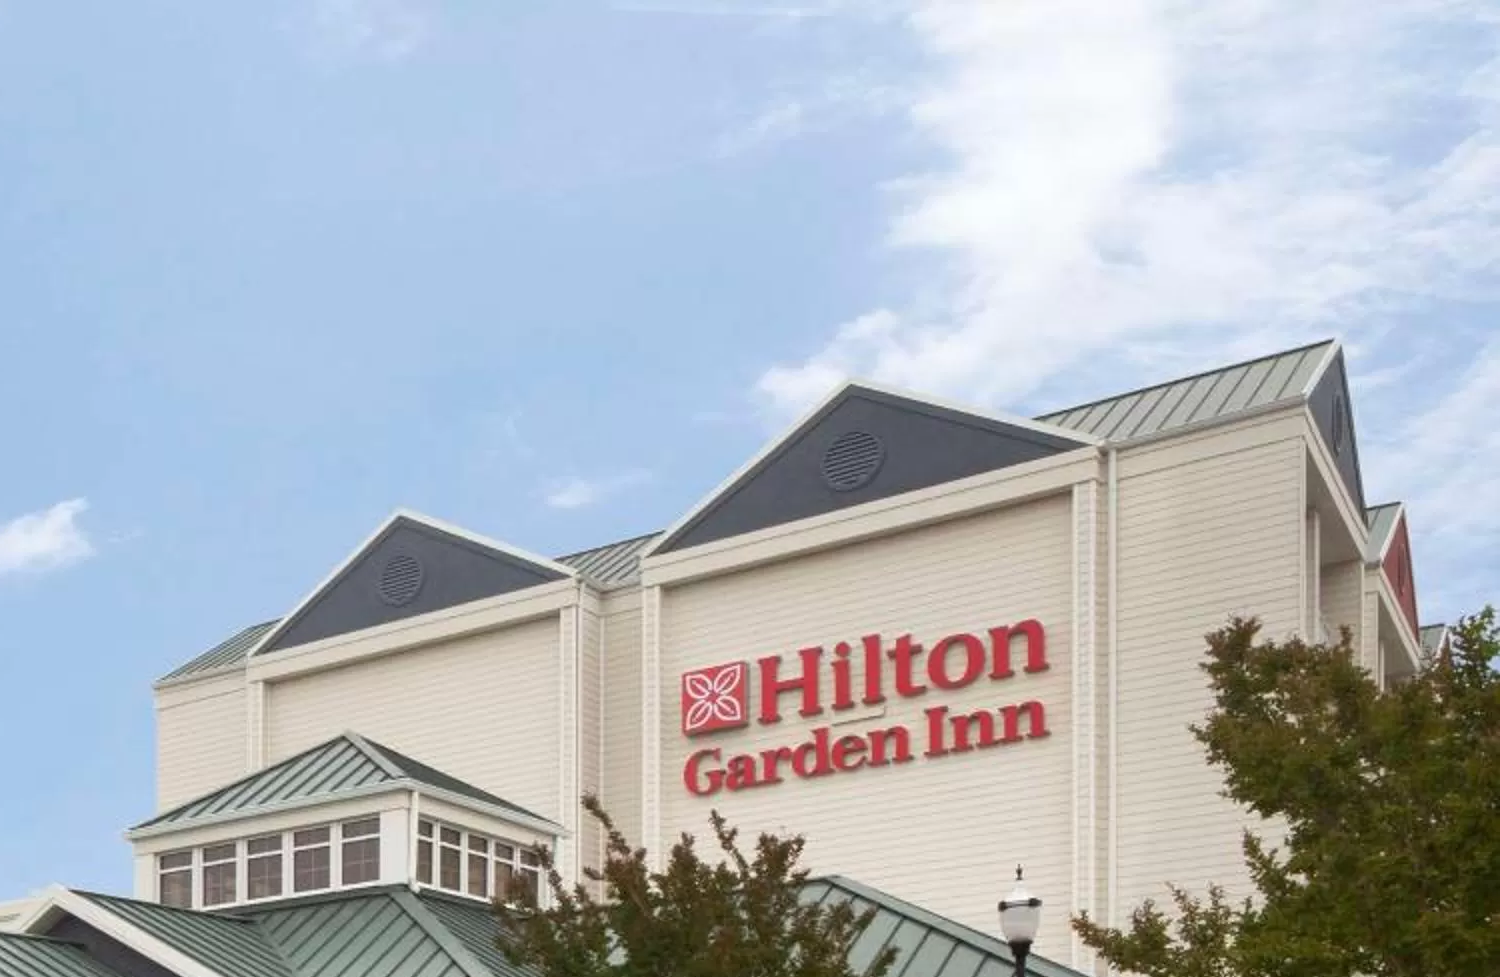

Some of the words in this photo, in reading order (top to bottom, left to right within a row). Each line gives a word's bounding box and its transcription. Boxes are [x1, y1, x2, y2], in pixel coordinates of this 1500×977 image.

[757, 618, 1049, 724] Hilton
[683, 724, 913, 796] Garden
[924, 698, 1051, 757] Inn
